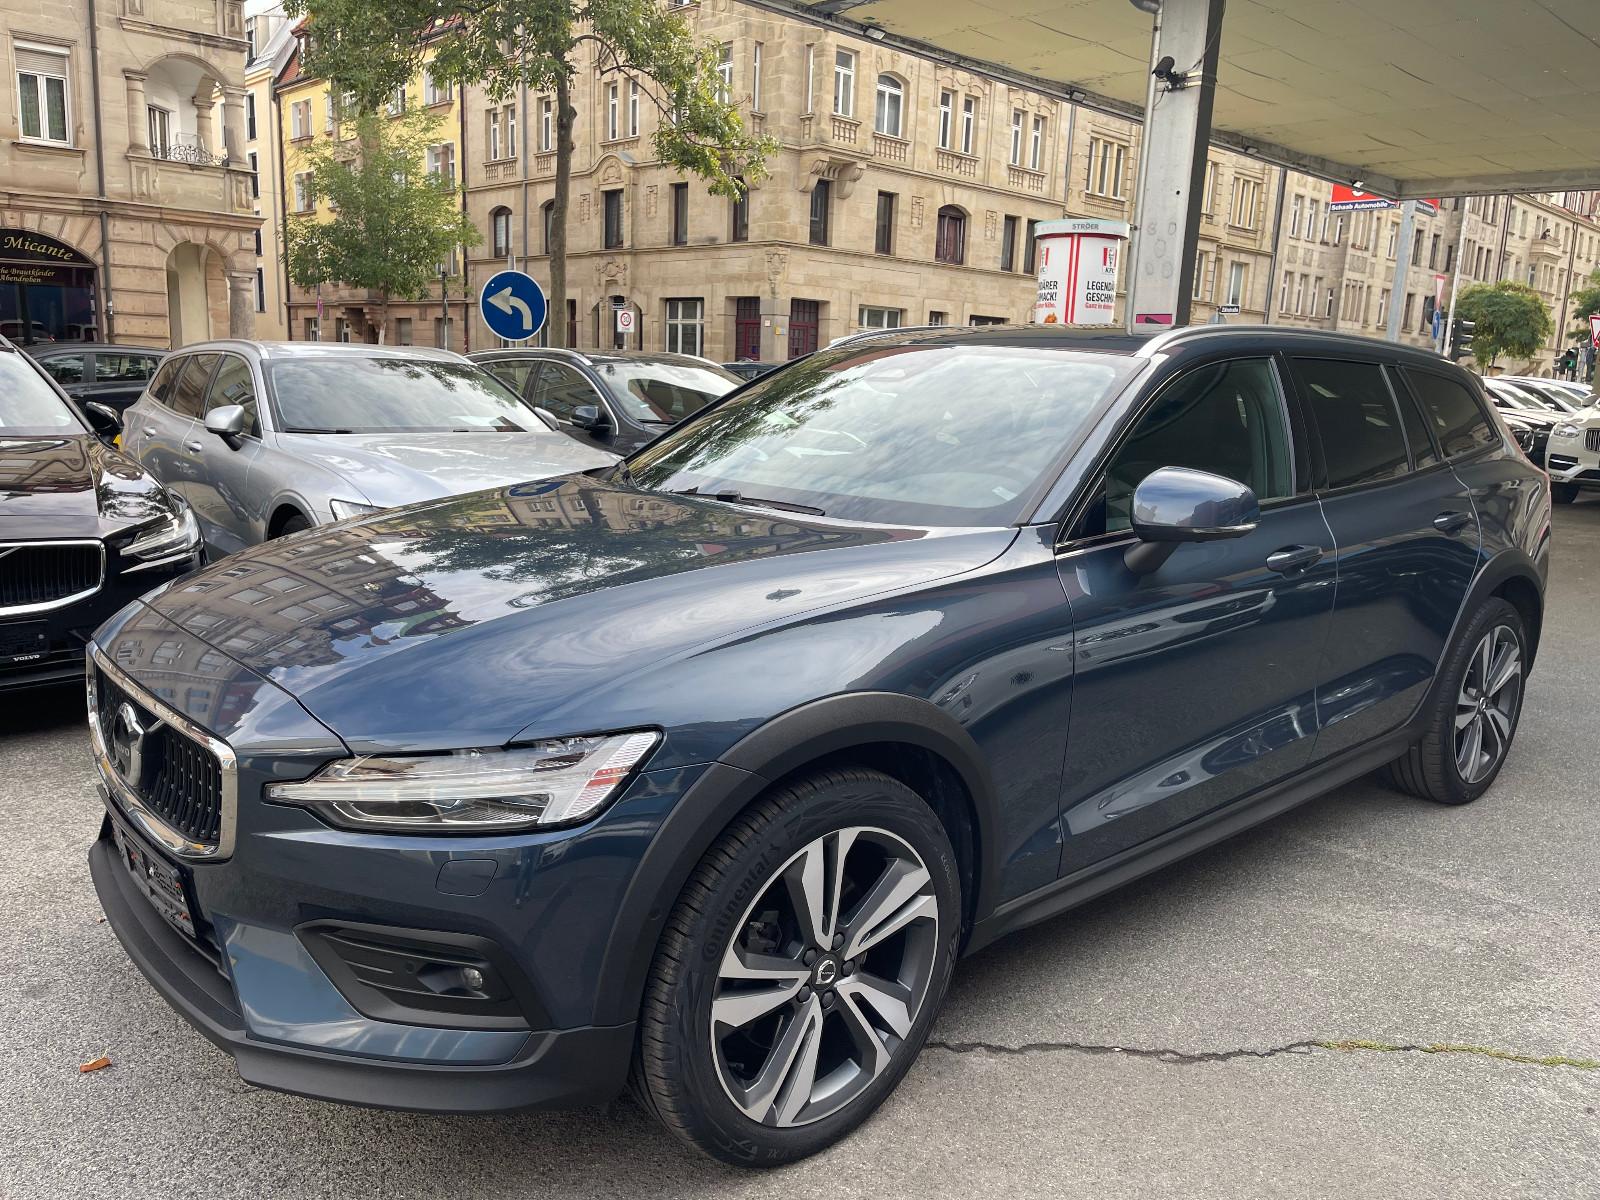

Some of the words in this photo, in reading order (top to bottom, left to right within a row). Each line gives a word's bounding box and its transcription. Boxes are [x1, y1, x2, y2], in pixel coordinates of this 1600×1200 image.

[1354, 201, 1388, 209] Automobile
[1072, 222, 1099, 231] STRÖER
[3, 235, 74, 260] Micante
[11, 267, 56, 277] Brautkleider
[13, 654, 40, 662] VOLVO
[702, 852, 771, 962] Continental
